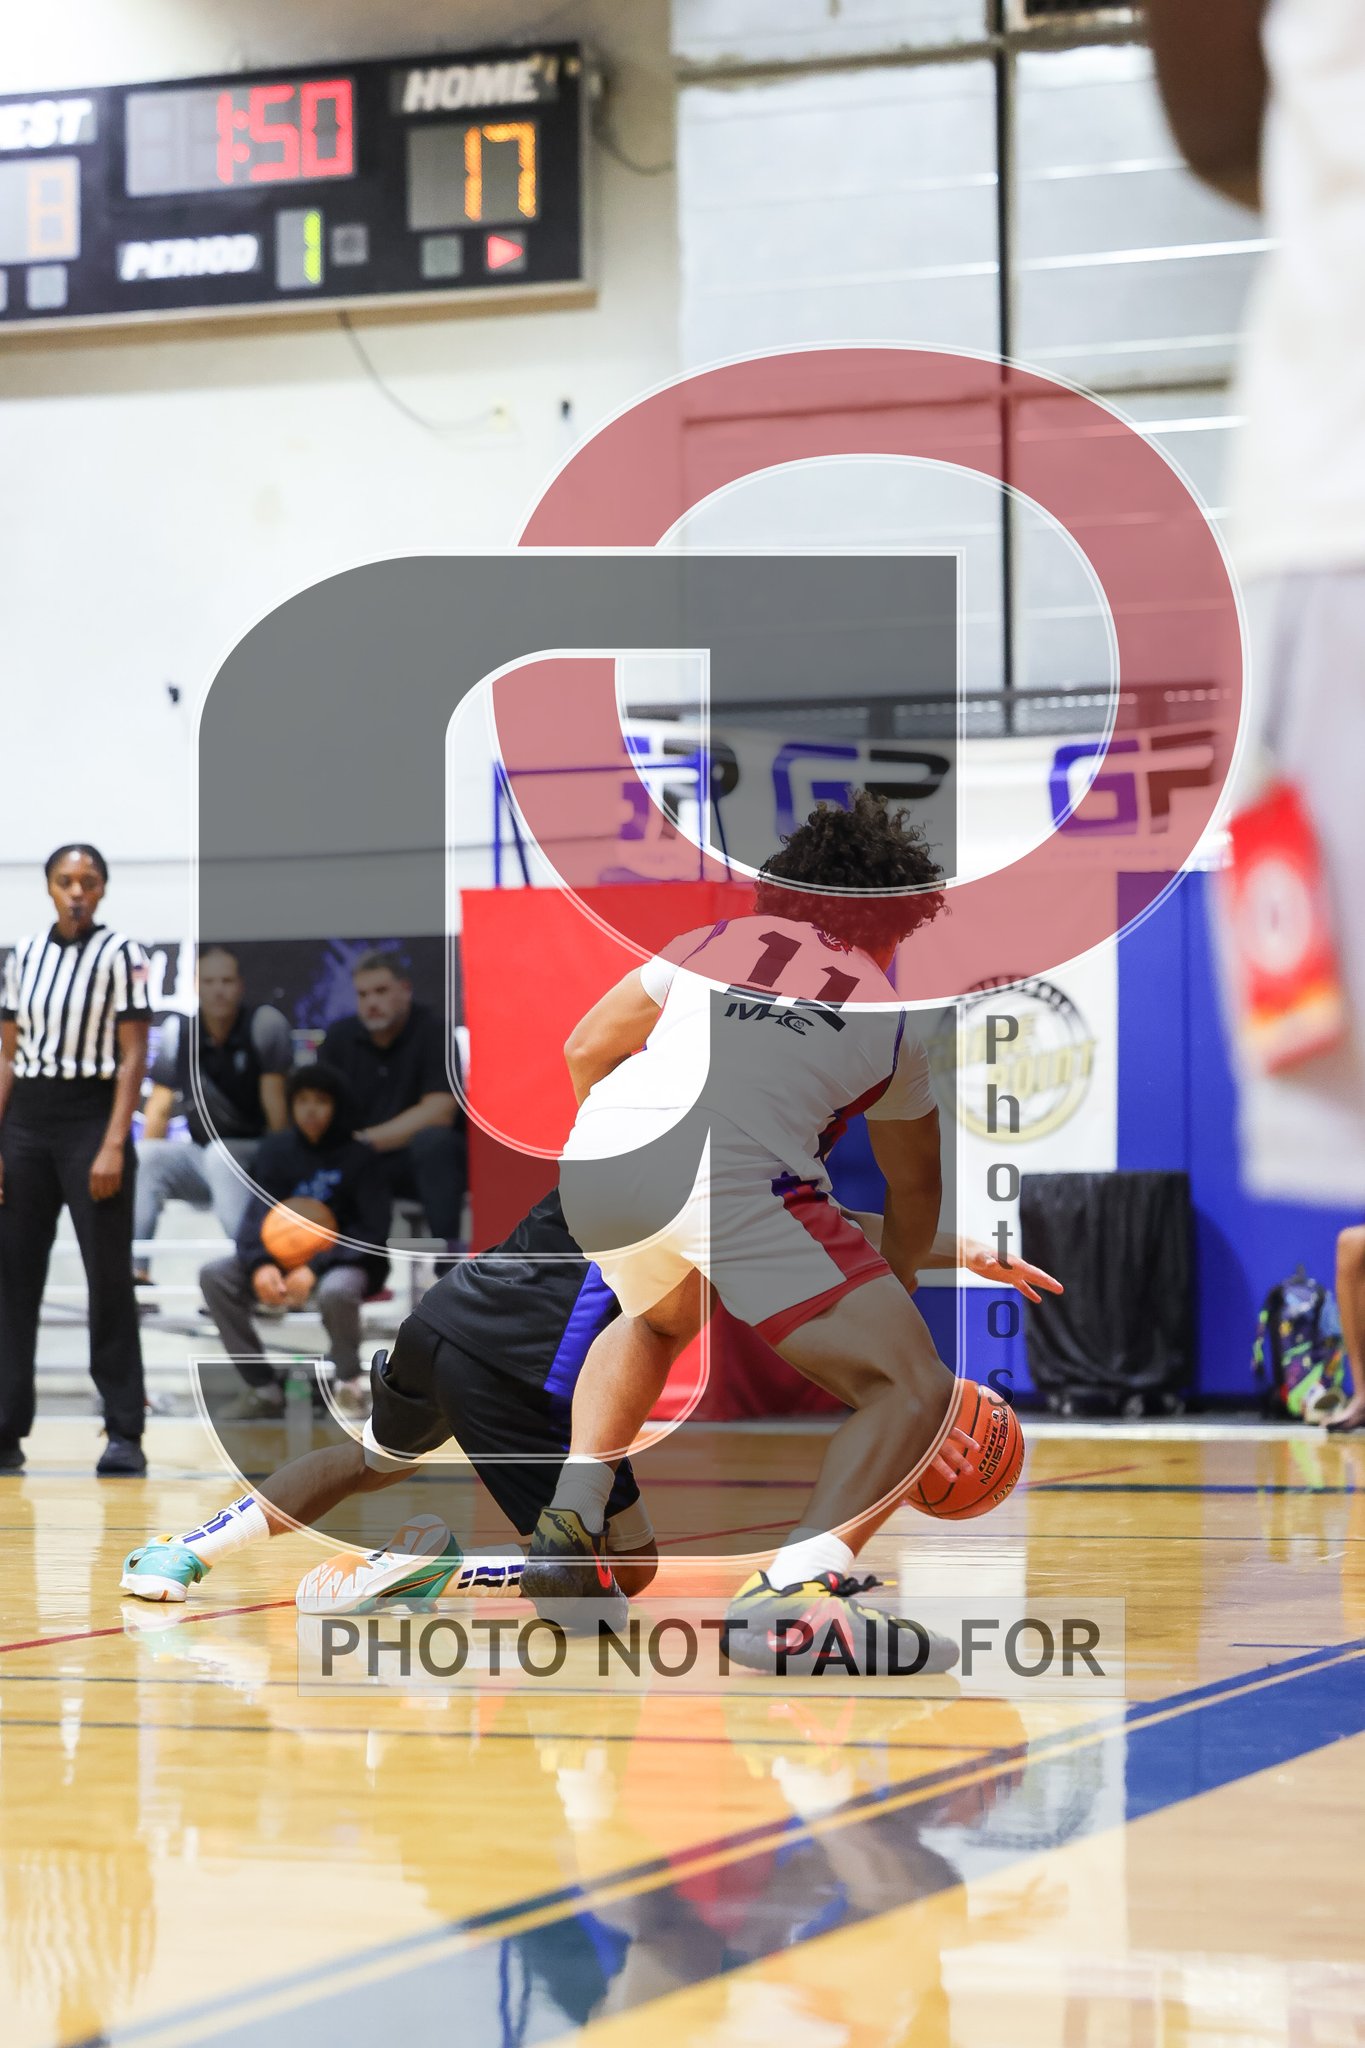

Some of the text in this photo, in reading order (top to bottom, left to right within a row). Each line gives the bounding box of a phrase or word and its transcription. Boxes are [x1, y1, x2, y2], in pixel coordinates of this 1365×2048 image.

[403, 61, 540, 113] HOME
[216, 79, 353, 184] 1:50
[464, 121, 536, 221] 17
[119, 234, 259, 281] PERIOD
[303, 210, 321, 284] 1
[978, 1425, 999, 1472] 1000
[980, 1405, 1009, 1485] PRECISION
